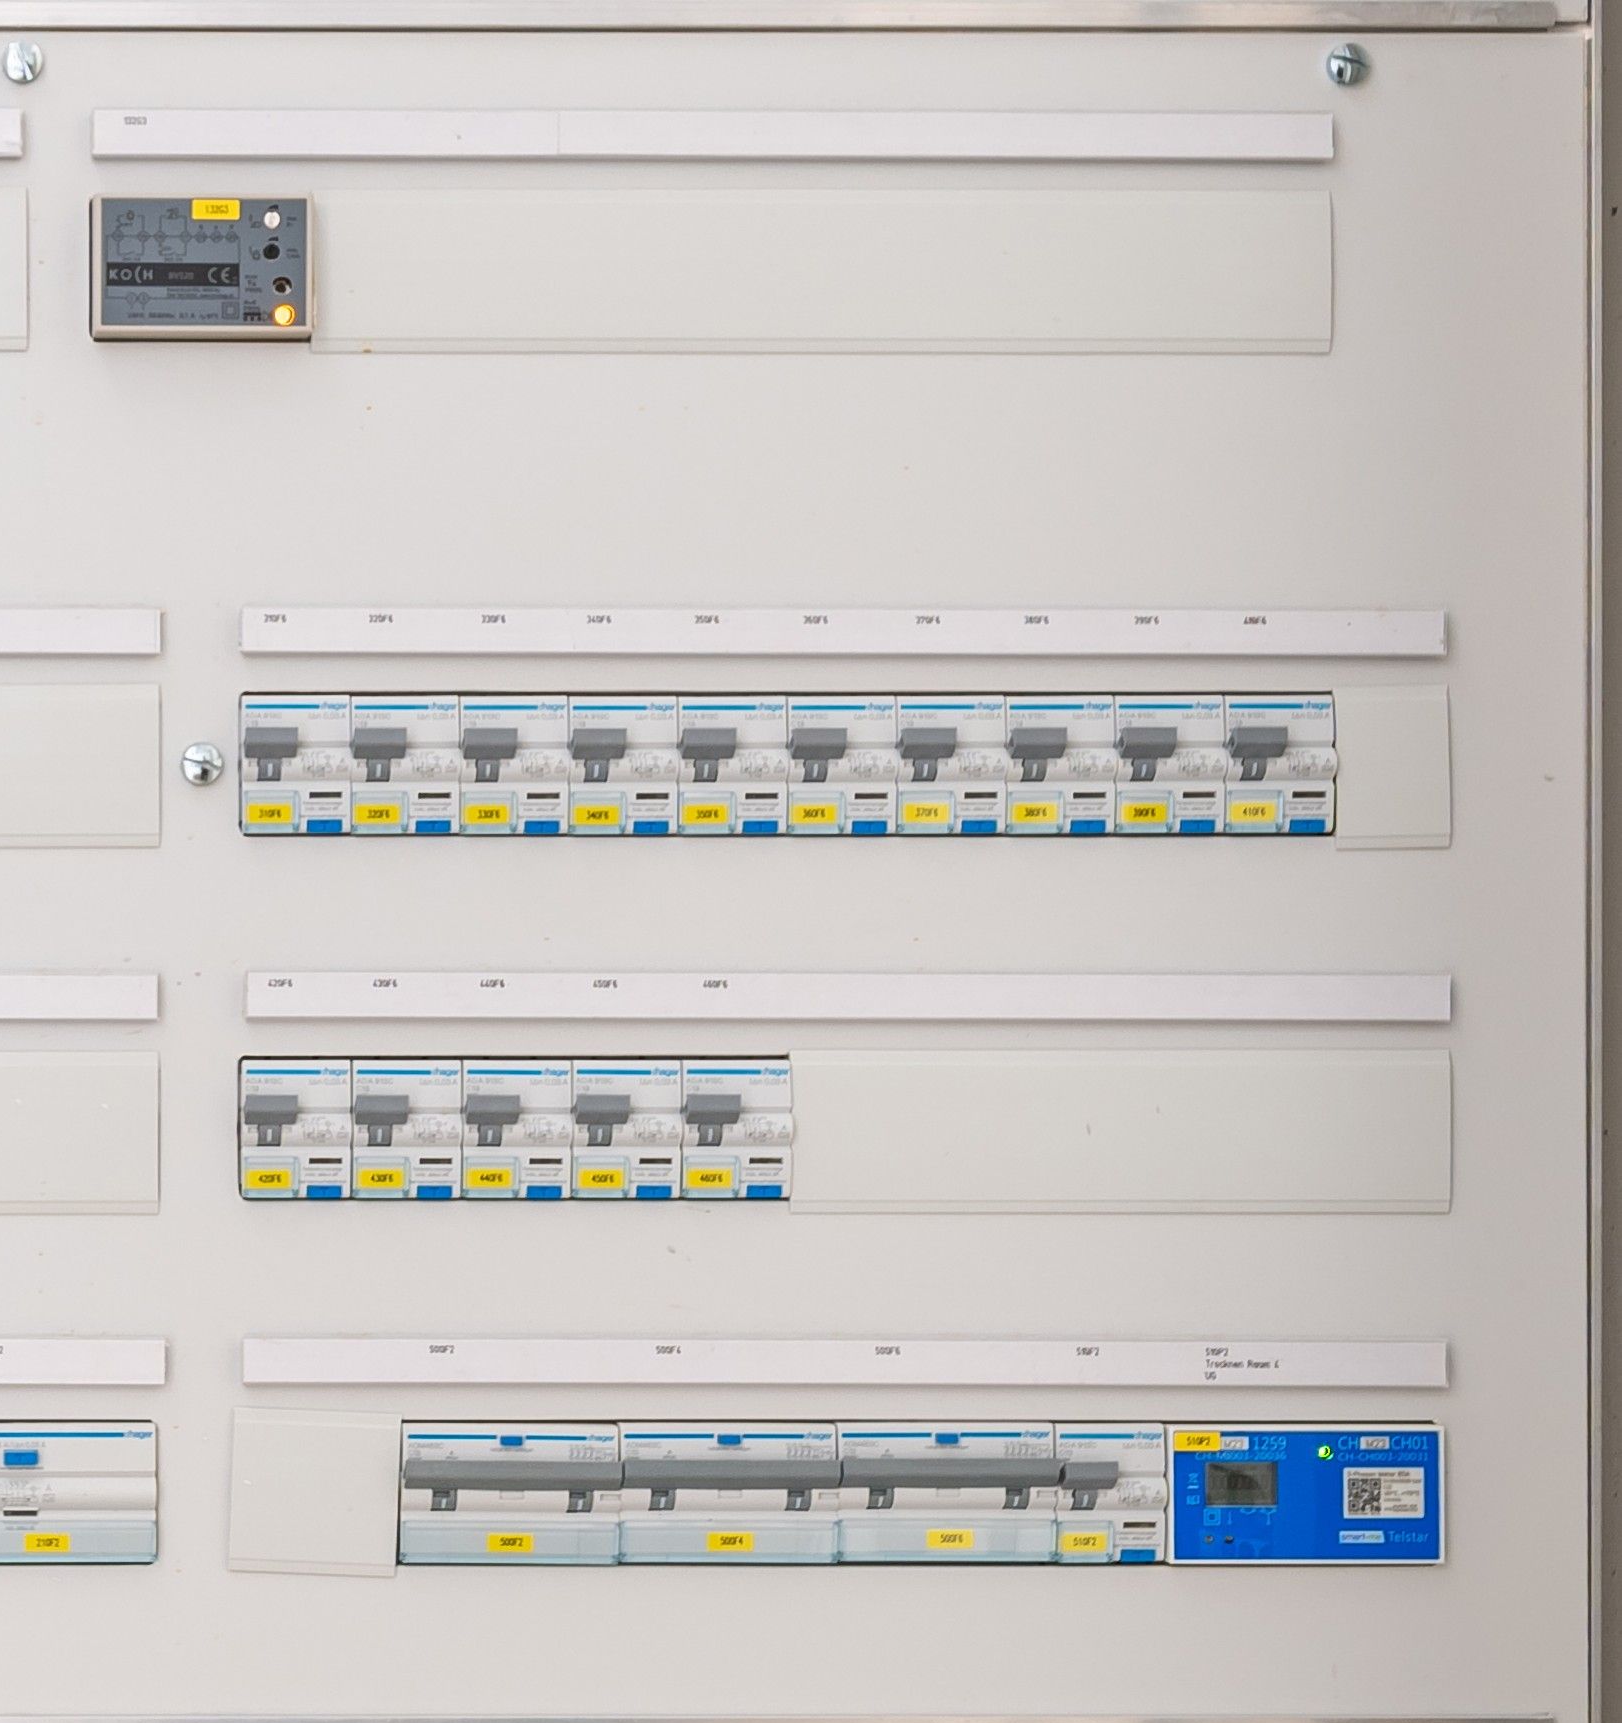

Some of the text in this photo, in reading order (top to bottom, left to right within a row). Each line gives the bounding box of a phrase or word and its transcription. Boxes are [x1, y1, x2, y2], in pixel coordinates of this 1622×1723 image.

[109, 266, 154, 283] KOCH
[207, 266, 232, 284] CE
[1252, 1435, 1287, 1450] 1259
[1390, 1435, 1430, 1450] CH01
[1388, 1529, 1430, 1543] Telstar
